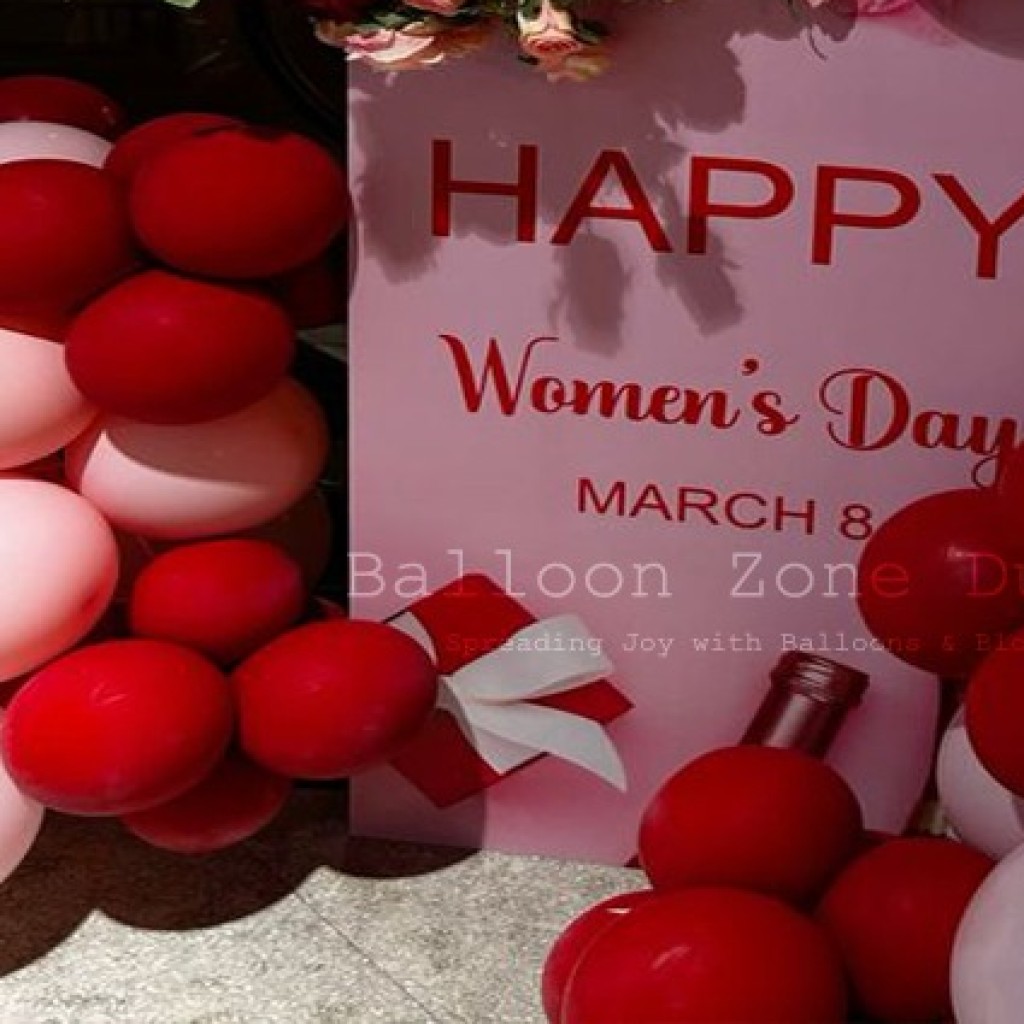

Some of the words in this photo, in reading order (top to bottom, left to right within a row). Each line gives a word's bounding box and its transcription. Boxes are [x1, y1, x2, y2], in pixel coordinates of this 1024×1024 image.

[438, 333, 799, 437] Women's
[818, 367, 1018, 489] Day
[576, 477, 816, 536] MARCH
[839, 502, 873, 541] 8
